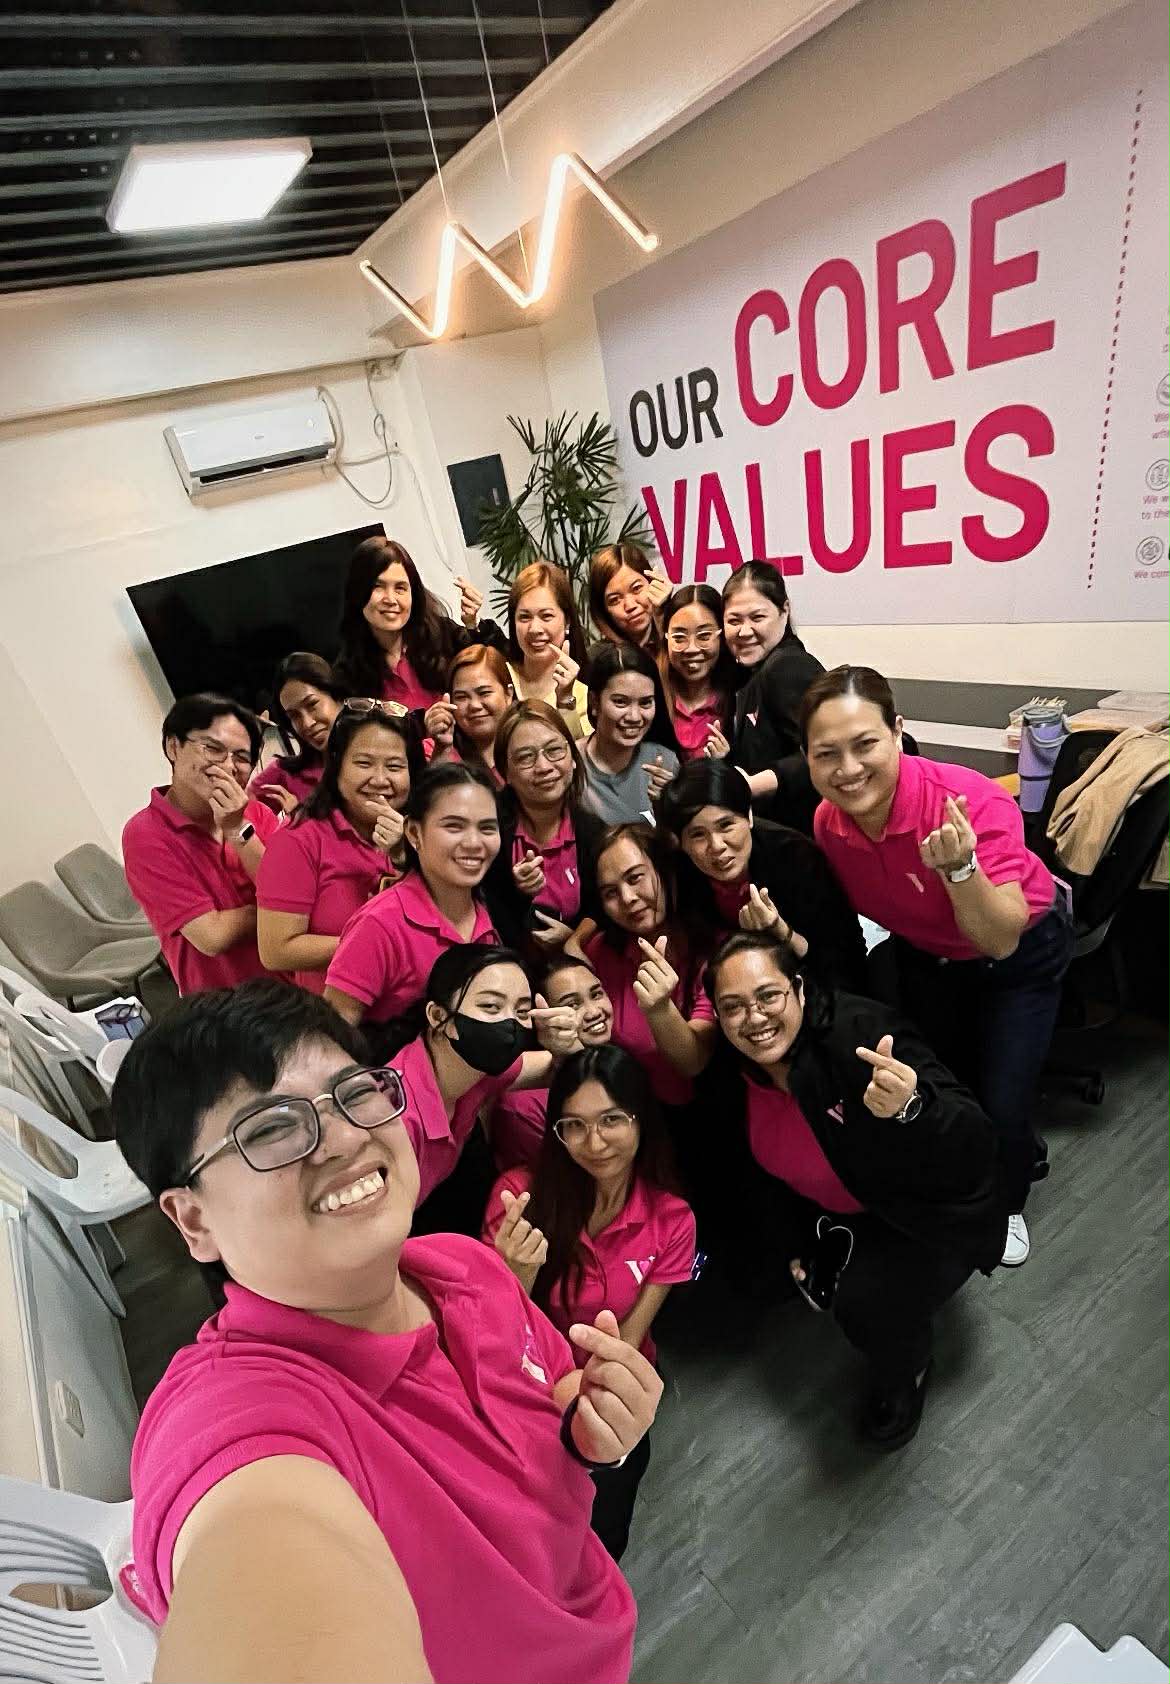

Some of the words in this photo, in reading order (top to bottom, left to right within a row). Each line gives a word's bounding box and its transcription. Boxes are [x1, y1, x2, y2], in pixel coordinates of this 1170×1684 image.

[629, 366, 724, 458] OUR
[735, 161, 1067, 427] CORE
[641, 404, 1055, 585] VALUES
